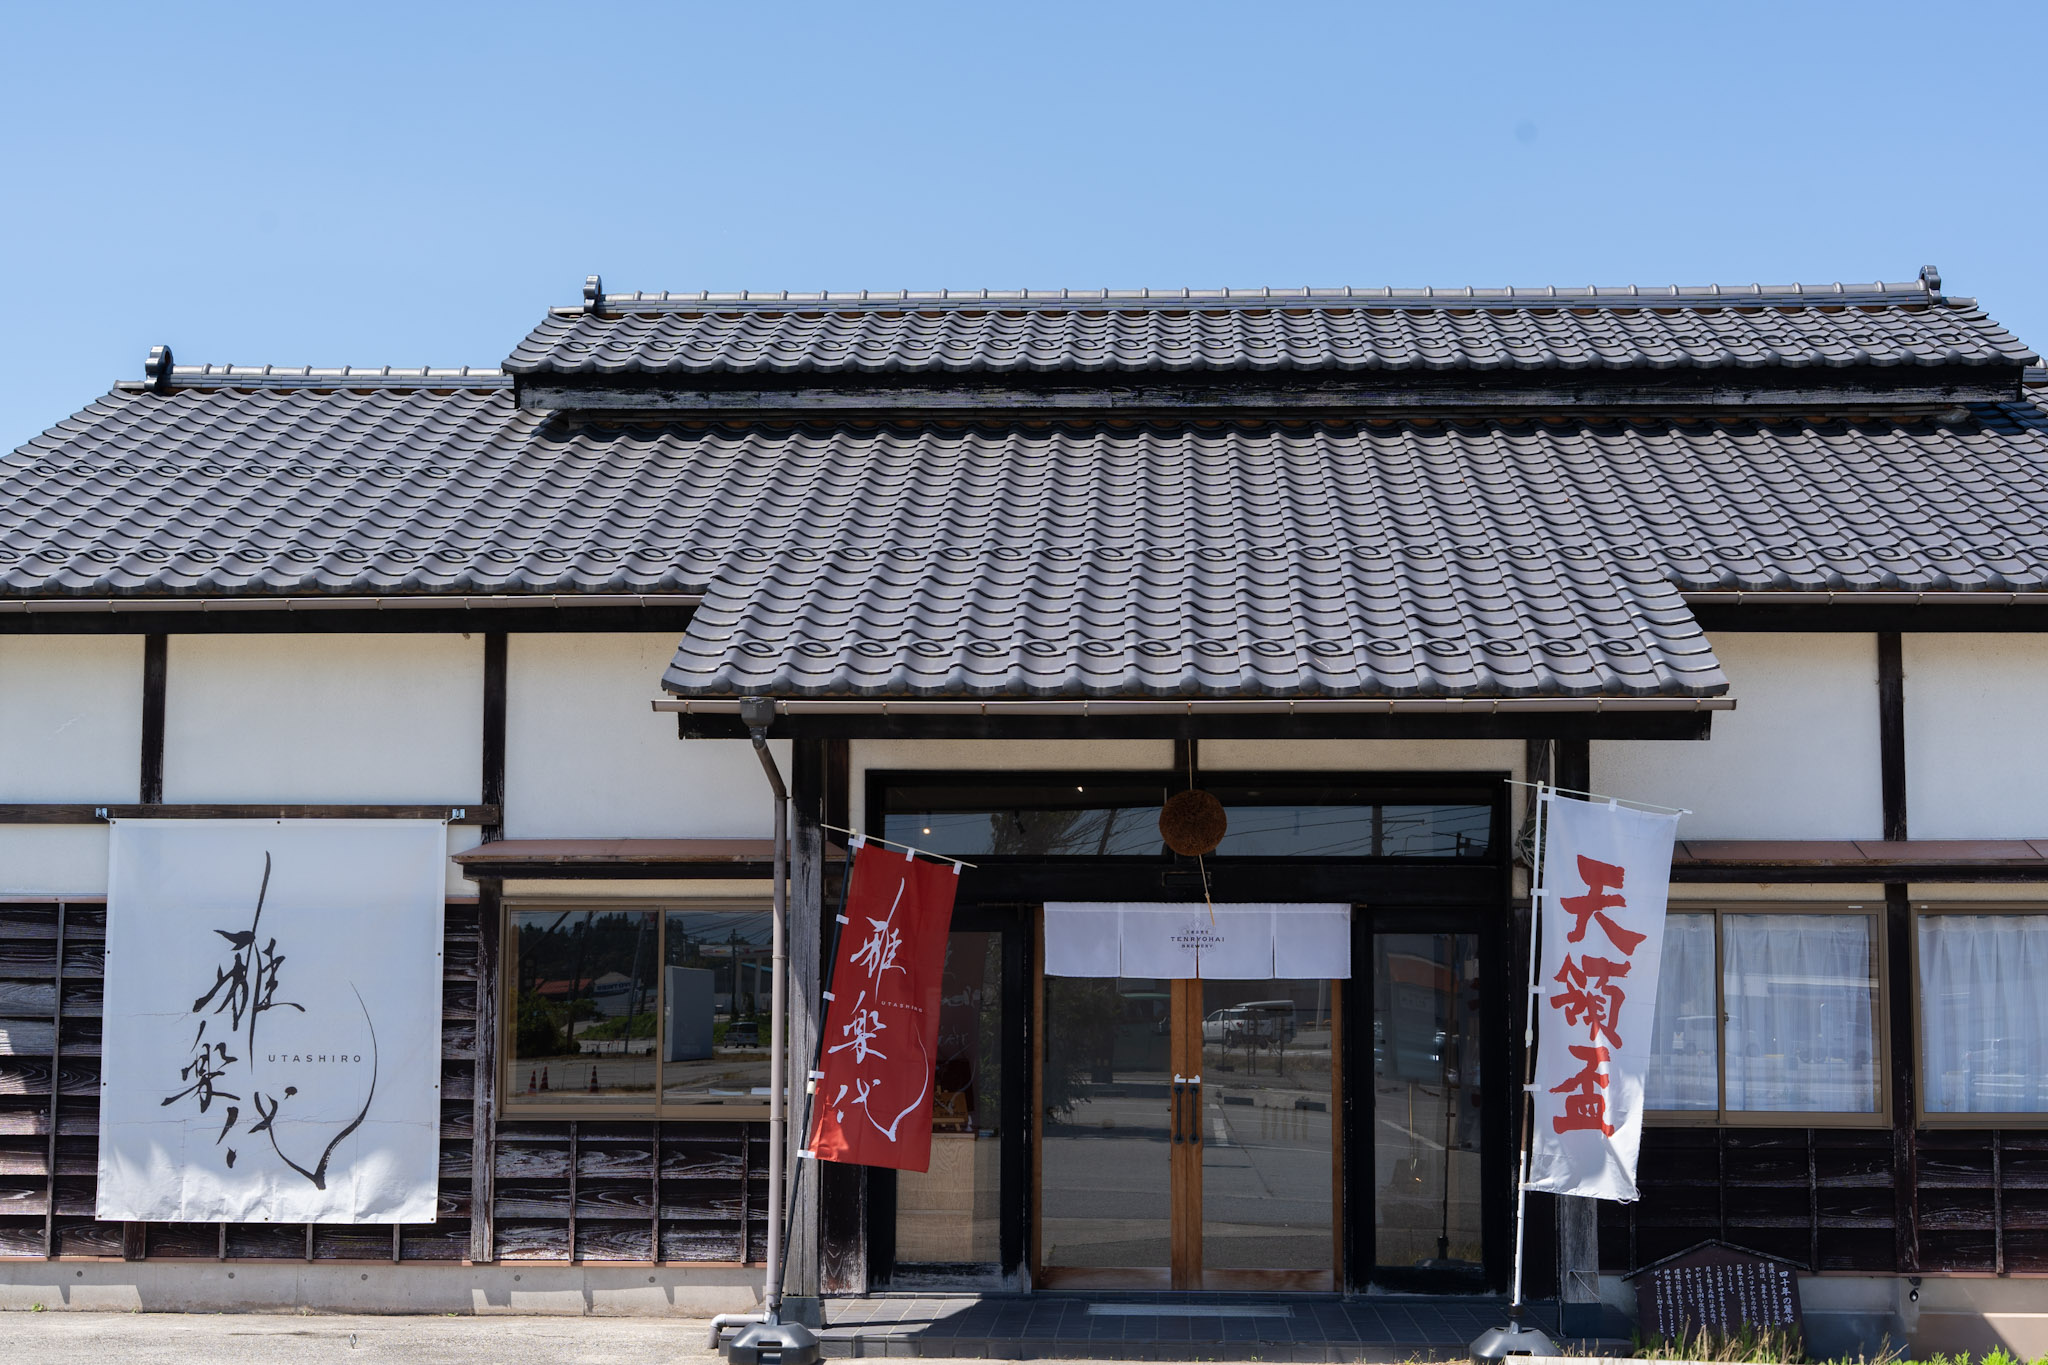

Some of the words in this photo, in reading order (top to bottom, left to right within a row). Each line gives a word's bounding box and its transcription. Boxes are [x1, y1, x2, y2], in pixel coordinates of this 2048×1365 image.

[1549, 854, 1647, 1138] 天領盃
[881, 1000, 924, 1013] UTASHIRO
[268, 1054, 362, 1064] UTASHIRO
